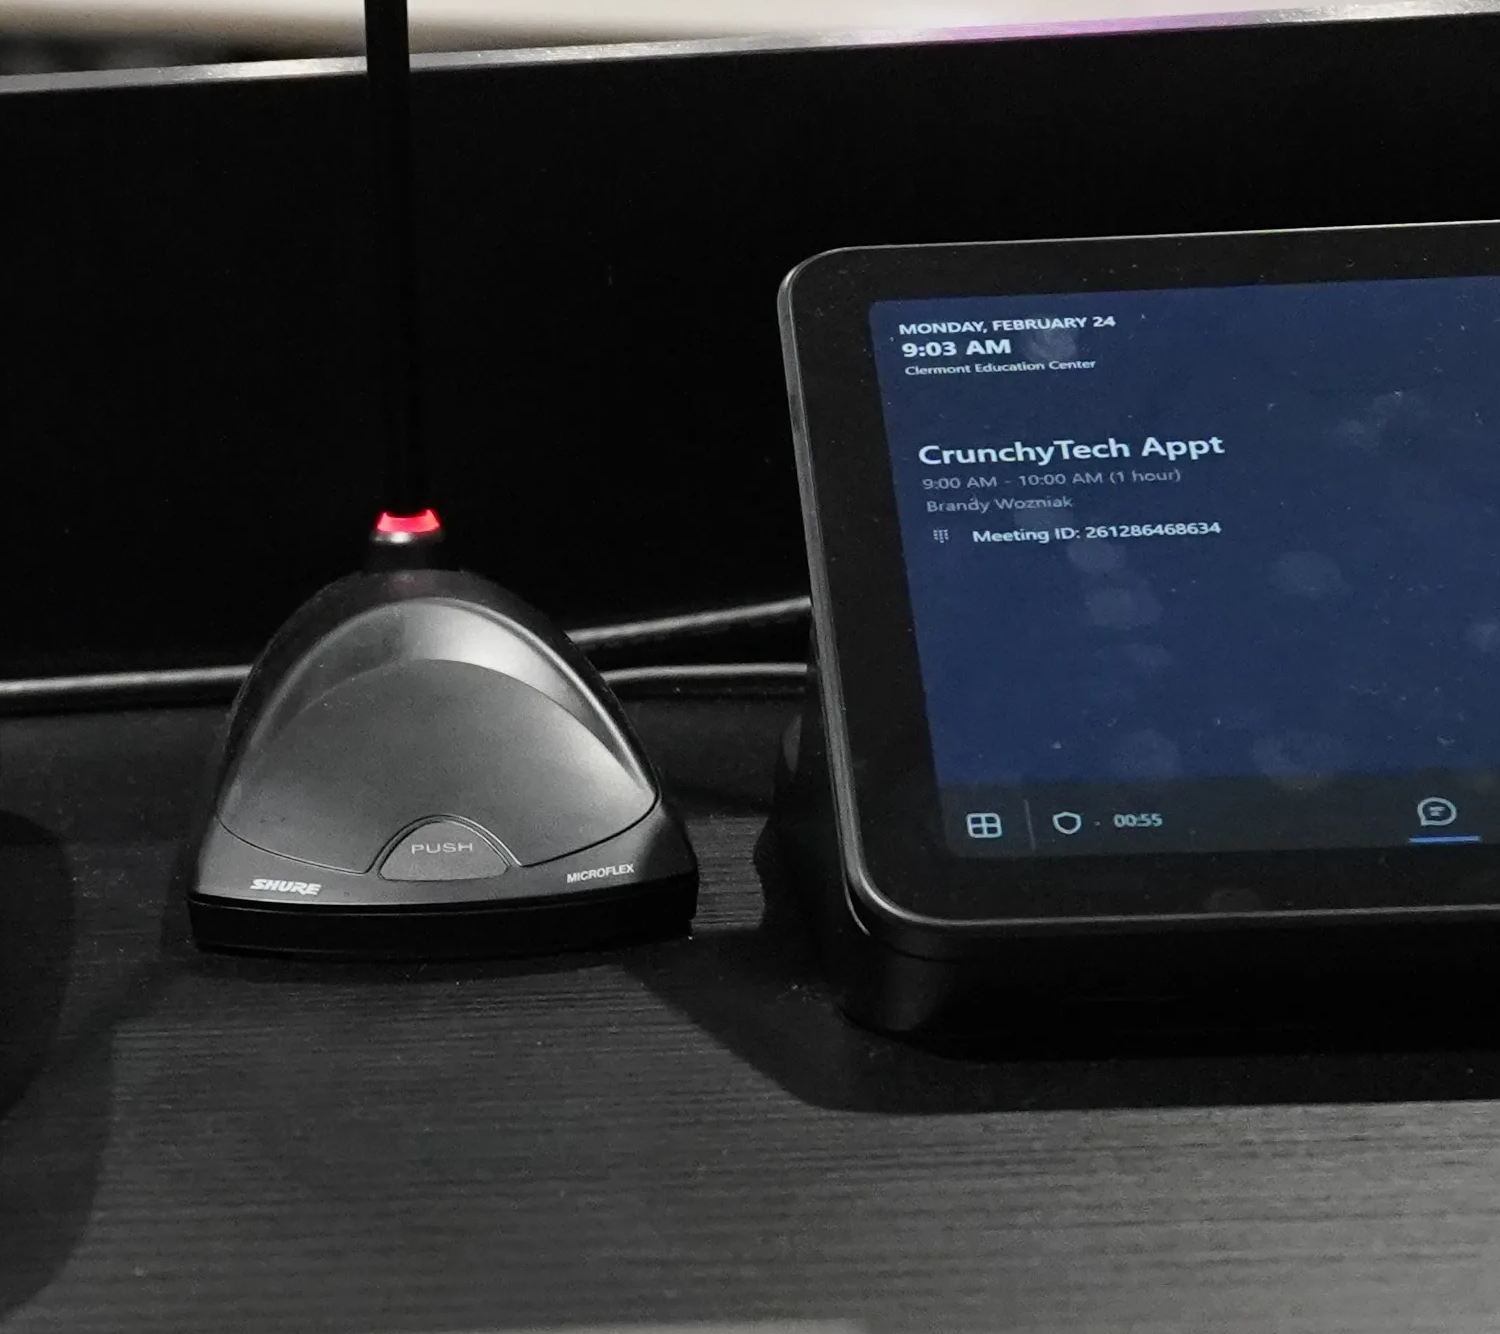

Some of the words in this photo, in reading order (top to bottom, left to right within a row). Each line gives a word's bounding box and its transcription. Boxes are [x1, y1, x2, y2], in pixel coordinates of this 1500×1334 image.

[899, 321, 988, 335] MONDAY,
[992, 317, 1087, 332] FEBRUARY
[1093, 316, 1116, 328] 24
[901, 341, 957, 358] 9:03
[965, 339, 1011, 355] AM
[905, 364, 971, 376] Clermont
[975, 360, 1046, 373] Education
[1049, 359, 1097, 371] Center
[918, 437, 1131, 466] CrunchyTech
[1141, 436, 1226, 461] Appt
[921, 477, 961, 491] 9:00
[966, 475, 998, 489] AM
[1018, 473, 1067, 487] 10:00
[1072, 471, 1104, 485] AM
[1109, 470, 1126, 485] (1
[1131, 468, 1181, 483] hour)
[926, 497, 990, 515] Brandy
[995, 496, 1074, 511] Wozniak
[972, 528, 1050, 544] Meeting
[1055, 527, 1081, 541] ID:
[1086, 522, 1222, 540] 261286468634
[1113, 813, 1163, 828] 00:55
[411, 842, 474, 855] PUSH
[566, 863, 635, 885] MICROFLEX
[249, 877, 322, 896] SHURE
